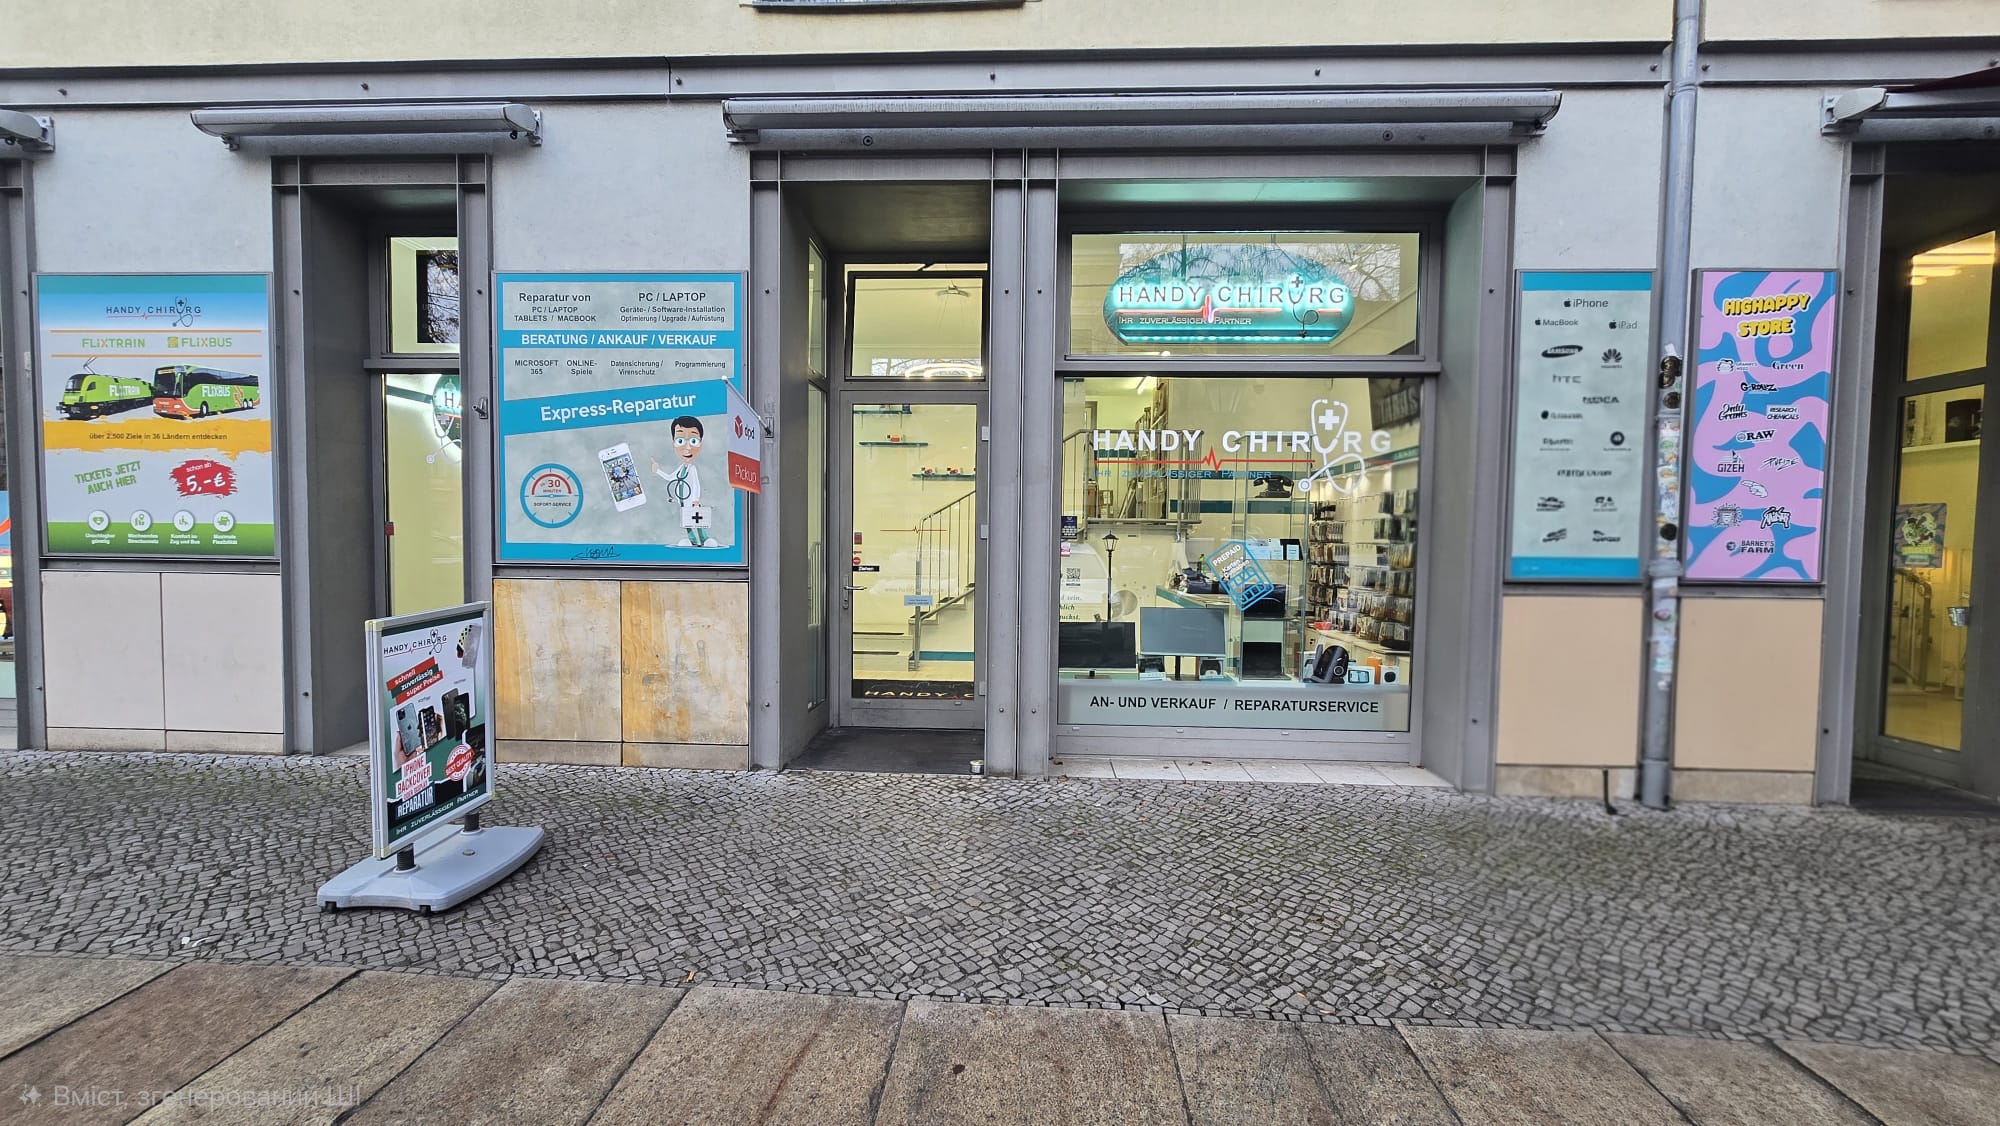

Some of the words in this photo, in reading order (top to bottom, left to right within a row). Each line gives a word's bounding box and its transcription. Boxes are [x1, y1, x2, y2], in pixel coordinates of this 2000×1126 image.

[519, 292, 569, 303] Reparatur
[572, 294, 591, 302] von
[638, 292, 655, 302] PC
[662, 292, 706, 302] LAPTOP
[1120, 286, 1202, 303] HANDY
[1218, 286, 1344, 304] CHIRURG
[1573, 299, 1609, 308] iPhone
[1724, 293, 1811, 316] HIGHAPPY
[106, 306, 141, 314] HANDY
[620, 305, 647, 313] Geräte-
[652, 305, 726, 313] Software-Installation
[620, 315, 657, 323] Optimierung
[662, 315, 687, 323] Upgrade
[691, 315, 725, 323] Aufrüstung
[1618, 320, 1638, 329] iPad
[1738, 317, 1793, 338] STORE
[521, 334, 588, 345] BERATUNG
[597, 334, 648, 345] ANKAUF
[658, 334, 717, 345] VERKAUF
[514, 359, 558, 367] MICROSOFT
[566, 359, 598, 367] ONLINE-
[610, 360, 660, 368] Datensicherung
[674, 360, 726, 369] Programmierung
[1772, 361, 1804, 370] Green
[570, 368, 593, 376] Spiele
[619, 368, 655, 376] Virenschutz
[540, 394, 697, 423] Express-Reparatur
[89, 432, 105, 440] über
[162, 432, 191, 440] Ländern
[1746, 430, 1775, 440] RAW
[1093, 429, 1203, 451] HANDY
[1222, 429, 1393, 453] CHIRURG
[74, 467, 113, 484] TICKETS
[115, 461, 142, 476] JETZT
[1717, 463, 1745, 473] GIZEH
[735, 464, 757, 483] Pickup
[1221, 470, 1272, 479] PANER
[87, 481, 114, 495] AUCH
[115, 475, 137, 489] HIER
[547, 479, 561, 488] 30
[1212, 544, 1242, 567] PREPAID
[383, 643, 409, 655] HANDY
[394, 668, 416, 685] schnell
[406, 682, 423, 697] super
[423, 673, 441, 687] Preise
[1090, 695, 1115, 708] AN-
[1118, 696, 1147, 709] UND
[1151, 697, 1217, 709] VERKAUF
[1234, 699, 1379, 713] REPARATURSERVICE
[397, 766, 431, 795] BACKCOVER
[397, 785, 434, 817] REPARATUR
